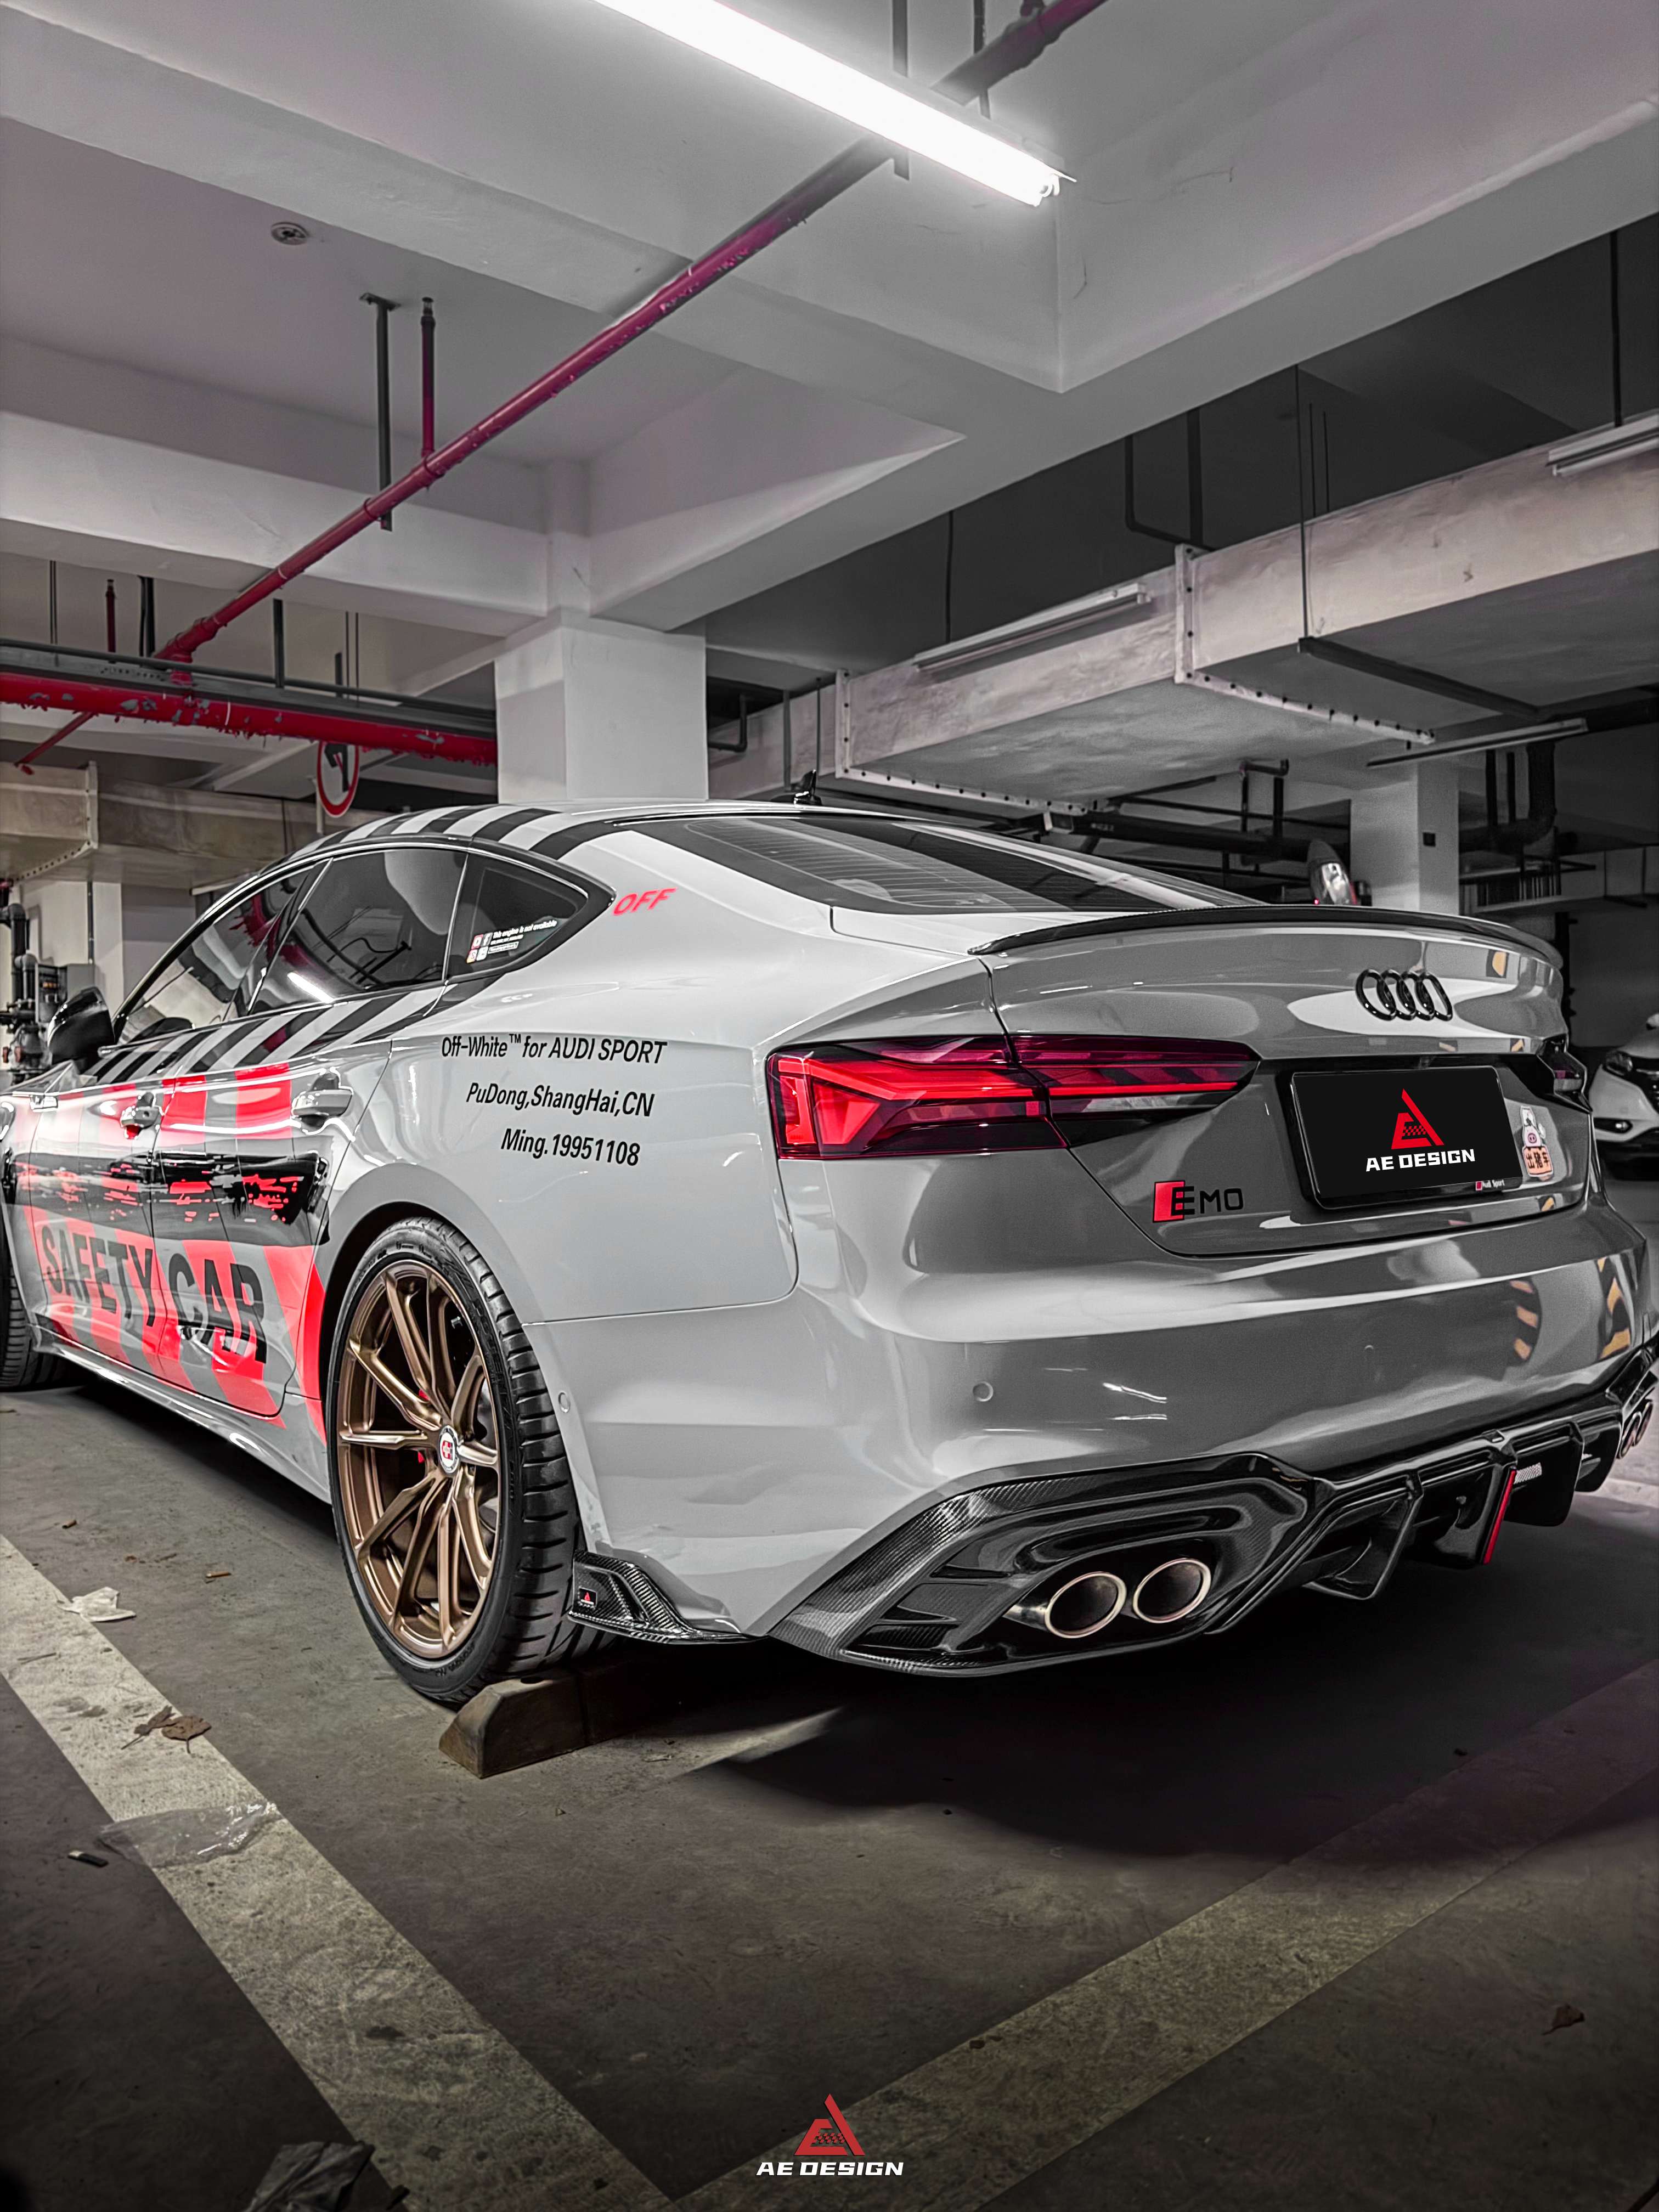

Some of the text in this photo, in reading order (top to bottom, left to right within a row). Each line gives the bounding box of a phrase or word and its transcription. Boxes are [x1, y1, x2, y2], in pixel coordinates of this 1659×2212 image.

[612, 887, 678, 916] OFF
[502, 928, 518, 937] engine
[533, 919, 557, 930] available
[522, 1035, 547, 1058] for
[548, 1037, 595, 1059] AUDI
[598, 1039, 668, 1063] SPORT
[466, 1082, 655, 1117] PuDong,ShangHai,CN
[1366, 1149, 1475, 1172] AE DESIGN
[1170, 1186, 1244, 1216] EMO
[42, 1226, 267, 1363] SAFETY CAR
